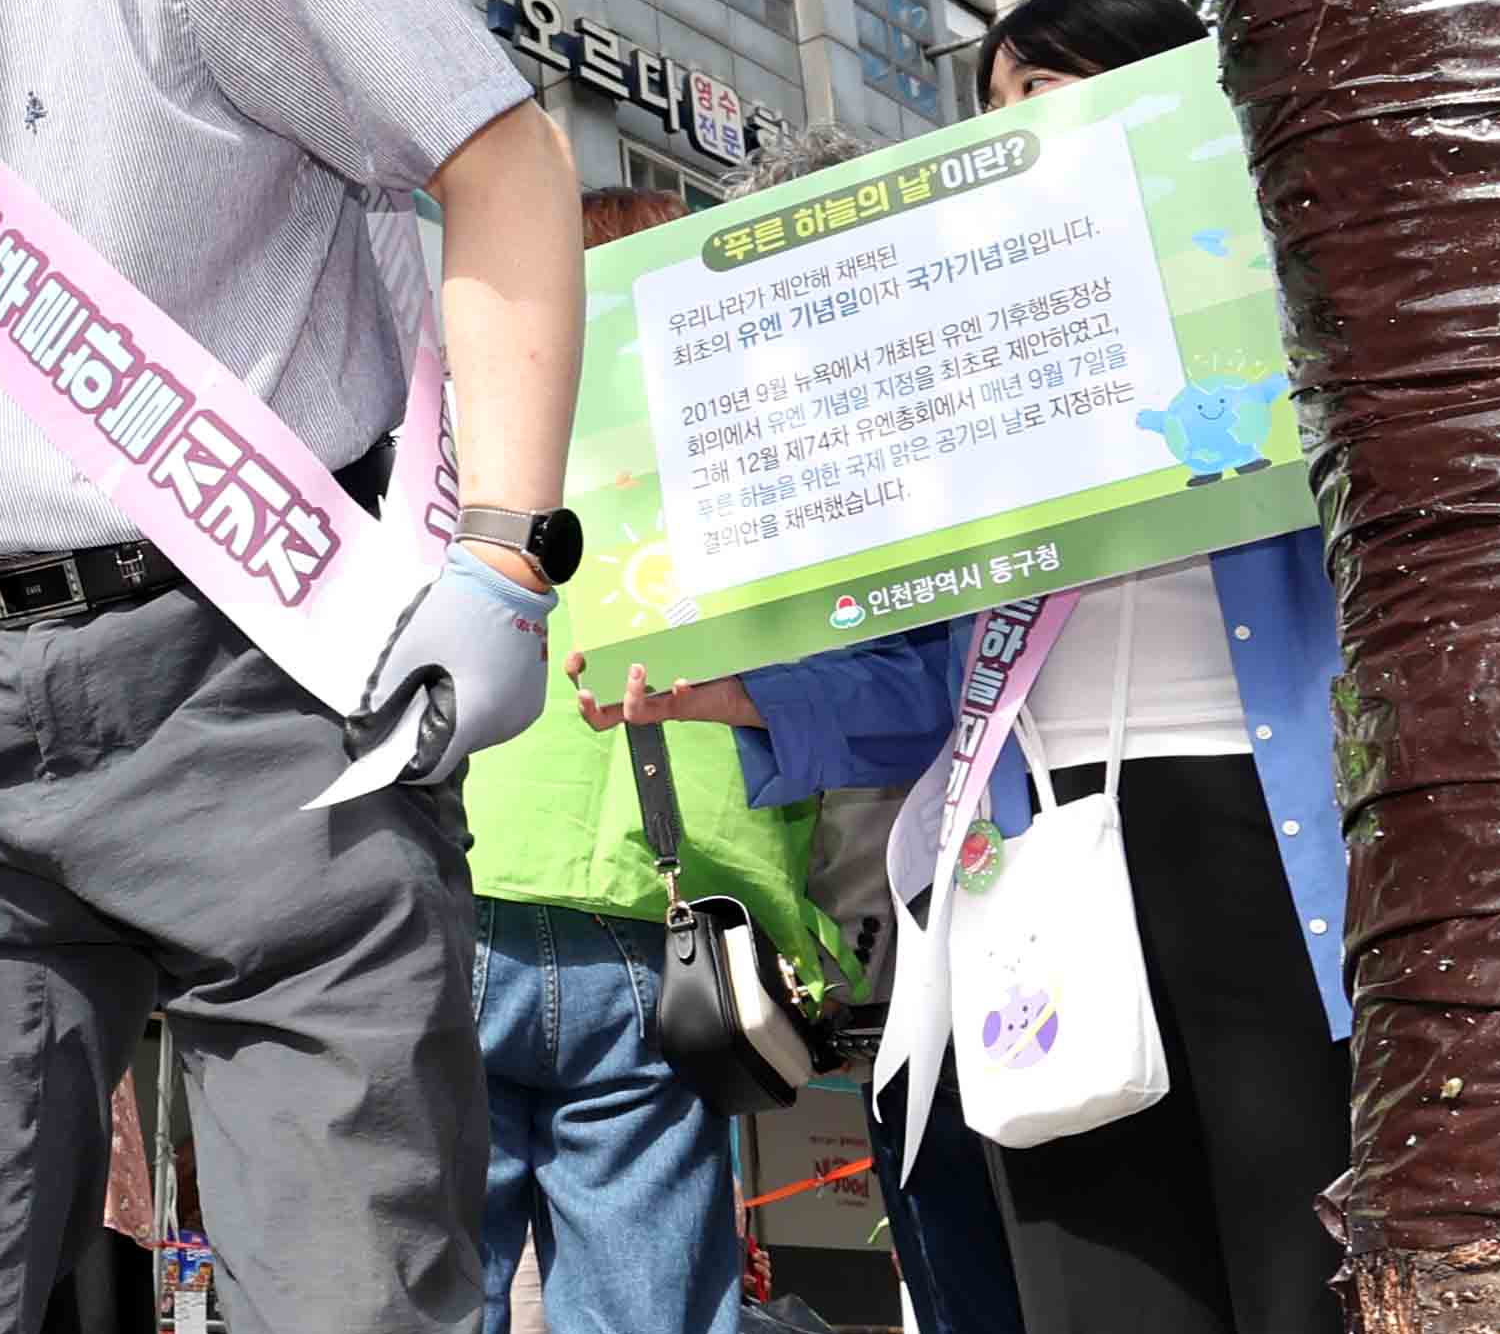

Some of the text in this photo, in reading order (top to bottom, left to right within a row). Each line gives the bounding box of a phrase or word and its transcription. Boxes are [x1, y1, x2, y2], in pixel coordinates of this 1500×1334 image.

[793, 182, 891, 239] 하늘의
[668, 244, 898, 339] 우리나라가 제안해 채택된
[673, 216, 1103, 367] 최초의 유엔 기념일이자 국가기념일입니다.
[681, 275, 1113, 427] 2019년 9월 뉴욕에서 개최된 유엔 기후행동정상
[687, 311, 1120, 459] 회의에서 유엔 기념일 지정을 최초로 제안하였고,
[691, 342, 1129, 490] 그해 12월 제74차 유엔총회에서 매년 9월 7일을
[740, 473, 797, 509] 하늘을
[801, 461, 841, 490] 위한
[846, 447, 886, 478] 국제
[935, 415, 998, 455] 공기의
[1001, 402, 1047, 437] 날로
[1048, 379, 1135, 420] 지정하는
[151, 407, 342, 609] 지키자
[785, 477, 911, 530] 채택했습니다.
[867, 542, 1061, 616] 인천광역시 동구청
